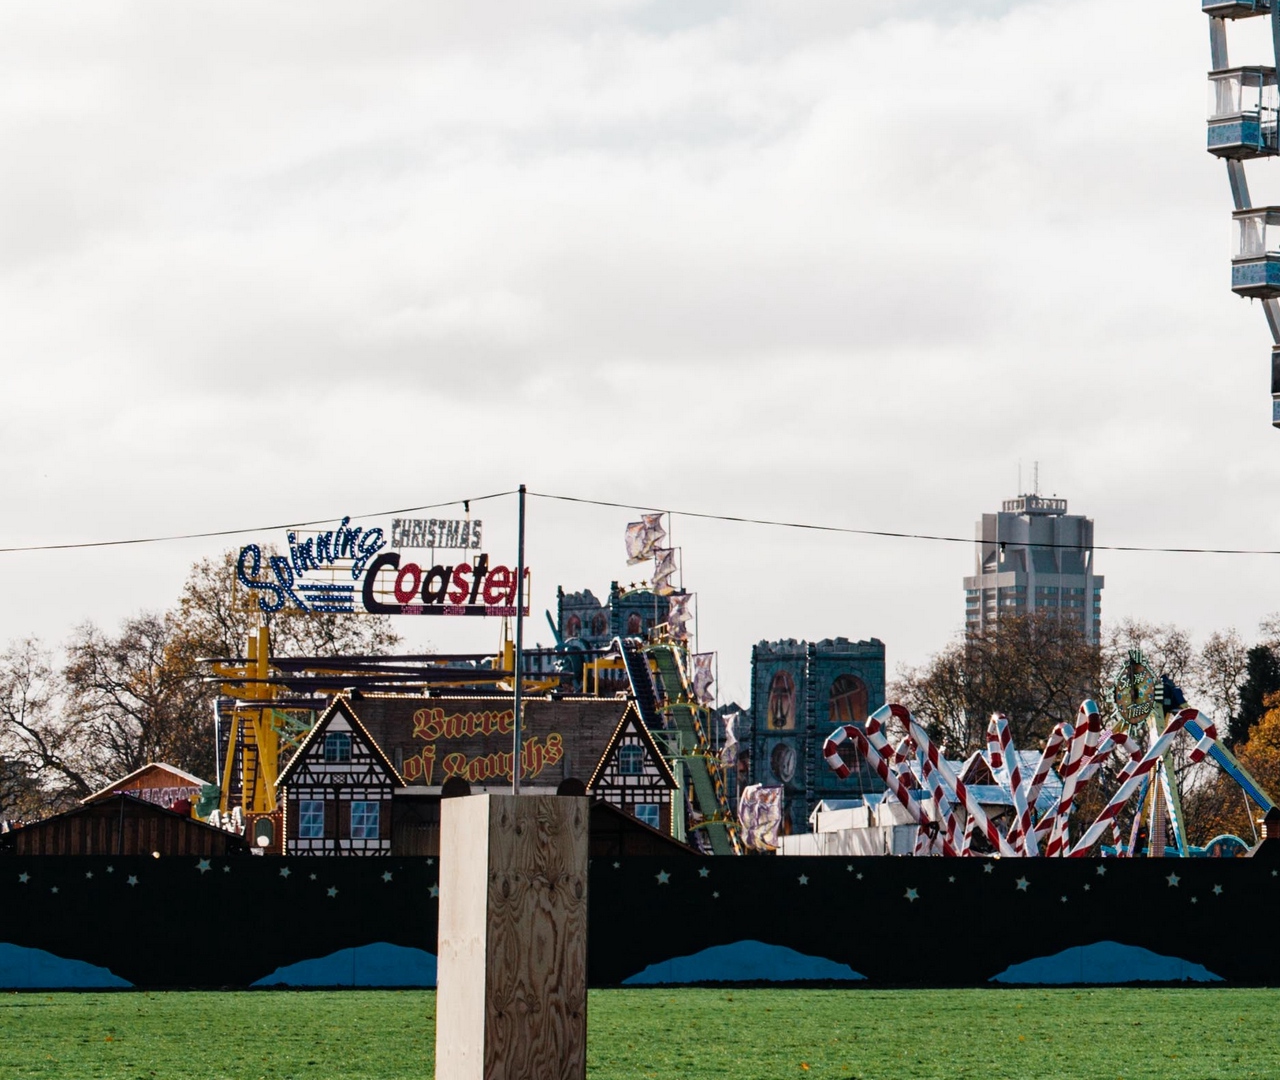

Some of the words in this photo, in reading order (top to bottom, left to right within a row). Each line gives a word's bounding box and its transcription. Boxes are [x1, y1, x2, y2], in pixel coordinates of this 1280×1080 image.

[391, 518, 482, 549] CHRISTMAS
[237, 516, 387, 613] Spinning
[362, 552, 529, 615] Coaster
[403, 744, 436, 786] of
[443, 732, 564, 783] Laughs
